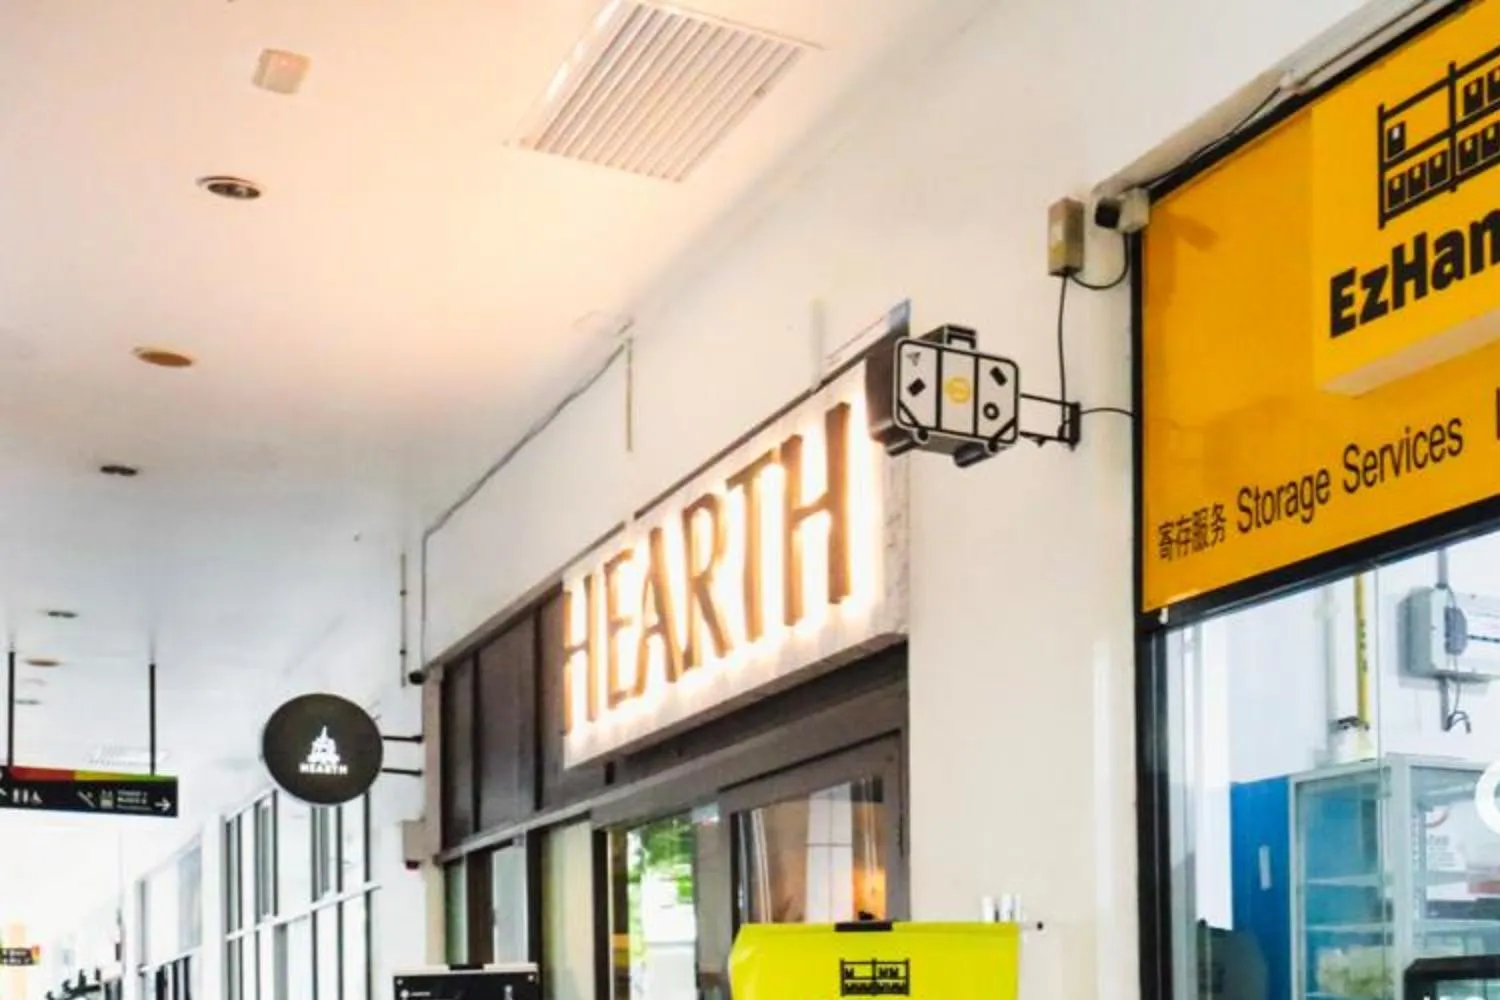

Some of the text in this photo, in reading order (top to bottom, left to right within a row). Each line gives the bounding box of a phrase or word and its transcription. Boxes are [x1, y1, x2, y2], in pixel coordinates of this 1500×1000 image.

[1157, 503, 1227, 562] 寄存服务
[1237, 468, 1331, 534] Storage
[1342, 417, 1463, 495] Services
[562, 402, 850, 736] HEARTH
